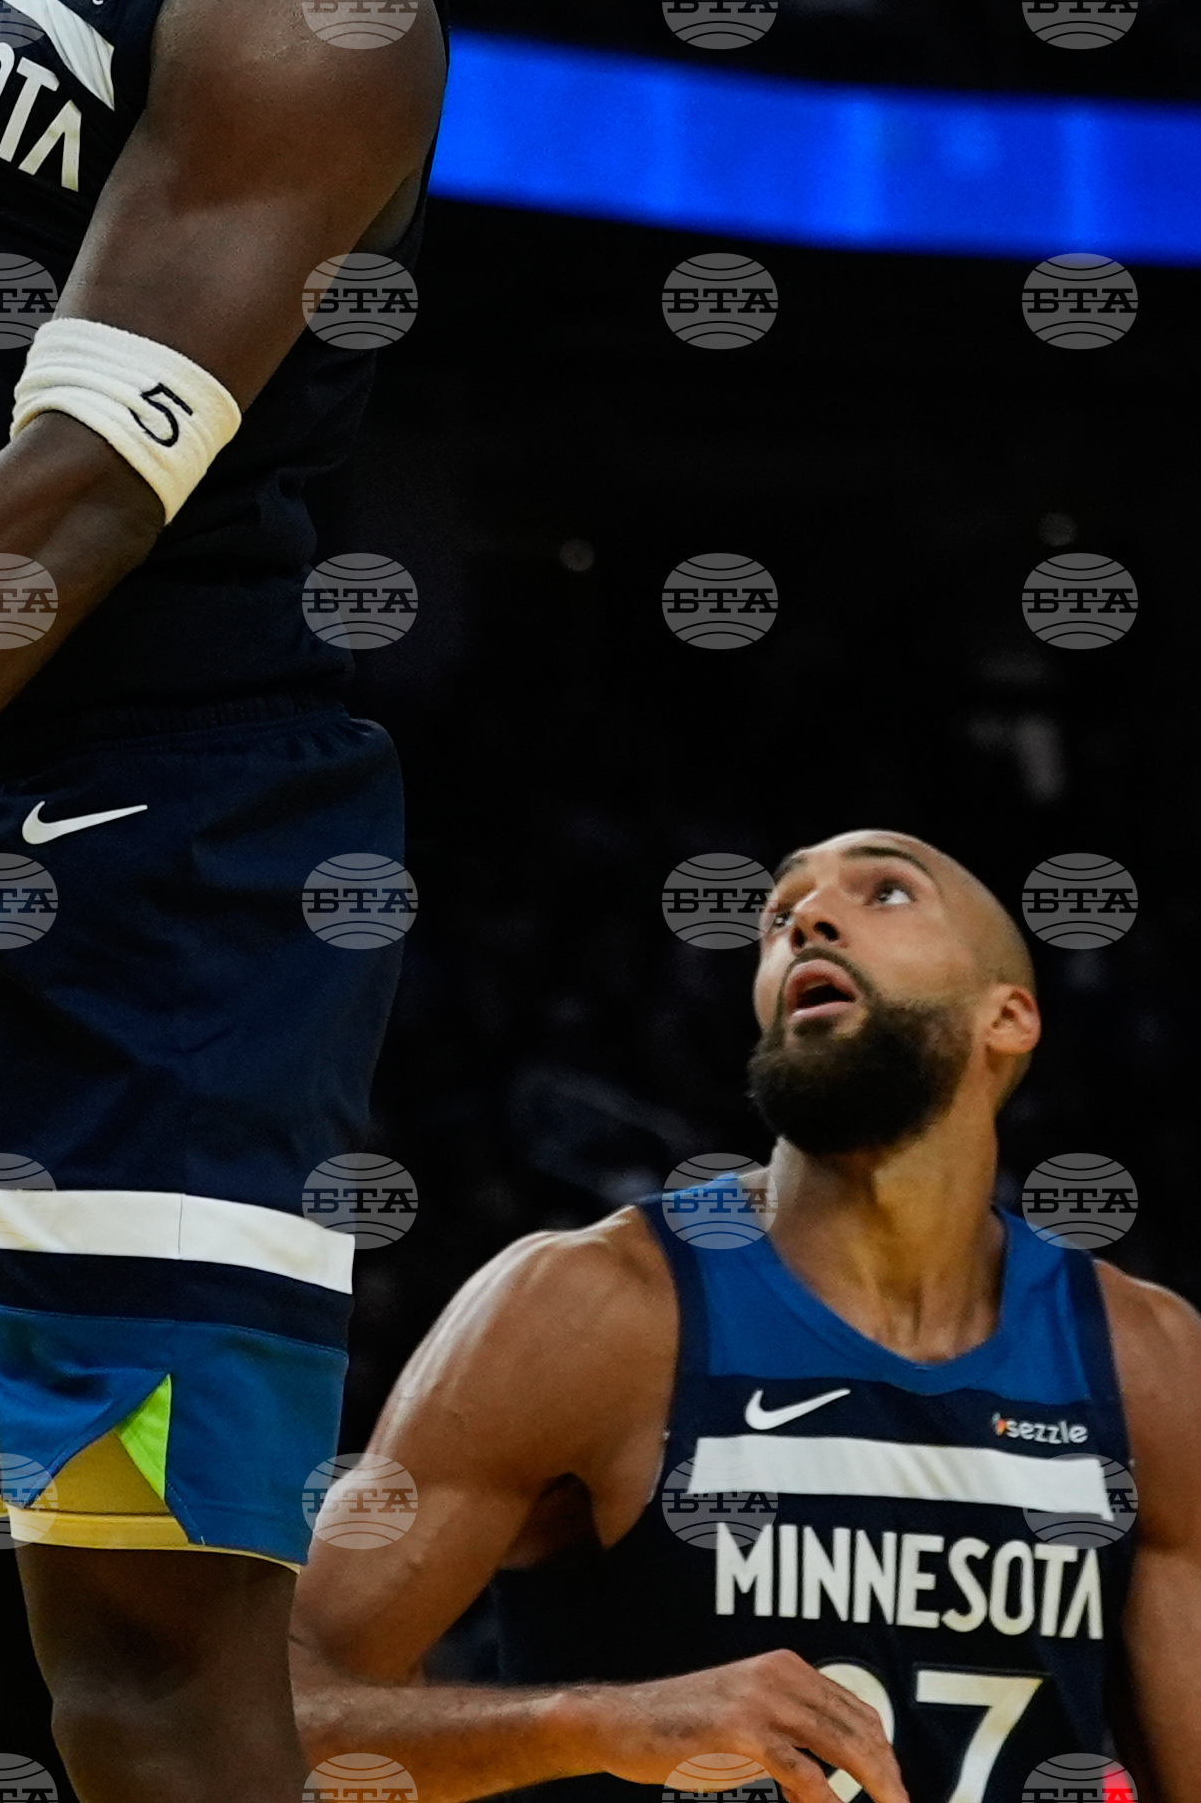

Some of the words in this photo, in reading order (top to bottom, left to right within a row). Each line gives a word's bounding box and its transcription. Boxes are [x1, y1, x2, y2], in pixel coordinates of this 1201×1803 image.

[127, 382, 194, 448] 5
[1005, 1419, 1089, 1444] sezzle
[716, 1522, 1103, 1640] MINNESOTA
